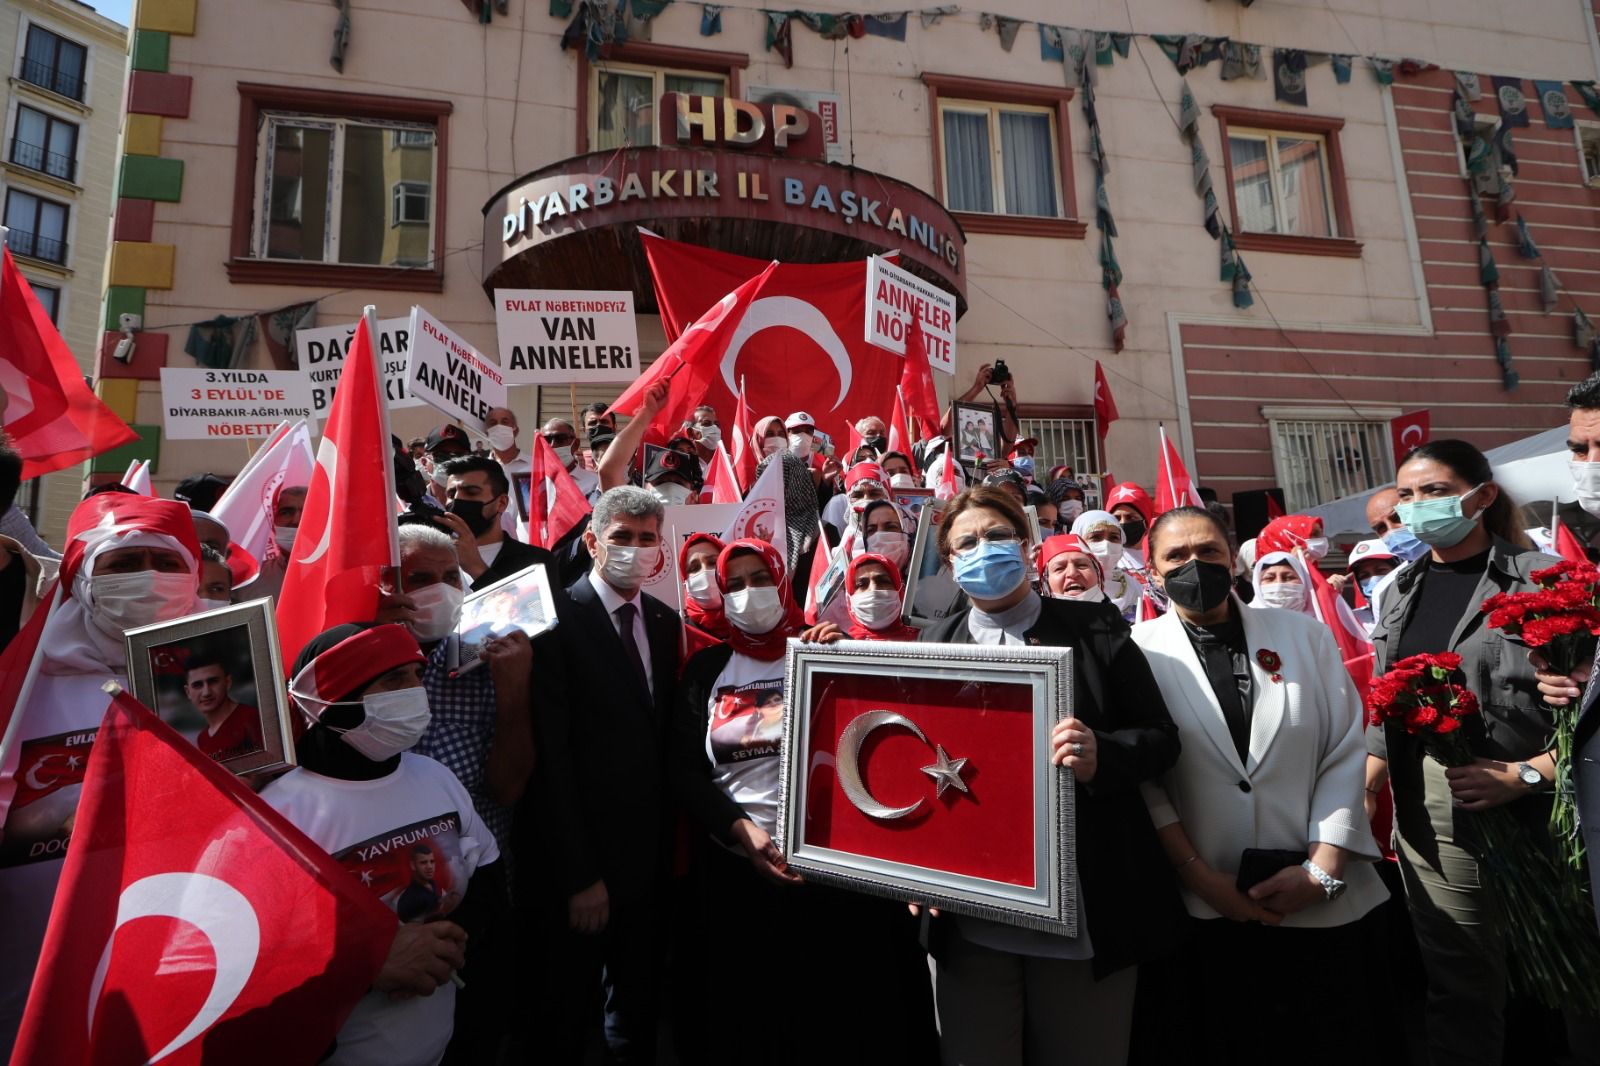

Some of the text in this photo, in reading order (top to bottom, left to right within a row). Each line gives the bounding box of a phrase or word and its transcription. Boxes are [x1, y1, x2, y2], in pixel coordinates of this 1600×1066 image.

[676, 92, 810, 150] HDP
[502, 168, 720, 243] DİYARBAKIR
[505, 300, 541, 312] EVLAT
[877, 279, 951, 334] ANNELER
[423, 320, 449, 346] EVLAT
[541, 317, 595, 341] VAN
[876, 309, 951, 363] NÖBTTE
[206, 371, 269, 384] 3.YILDA
[446, 352, 482, 395] VAN
[191, 387, 285, 401] 3 EYLÜL'DE
[65, 731, 99, 747] EVLA
[358, 827, 430, 862] YAVRUM
